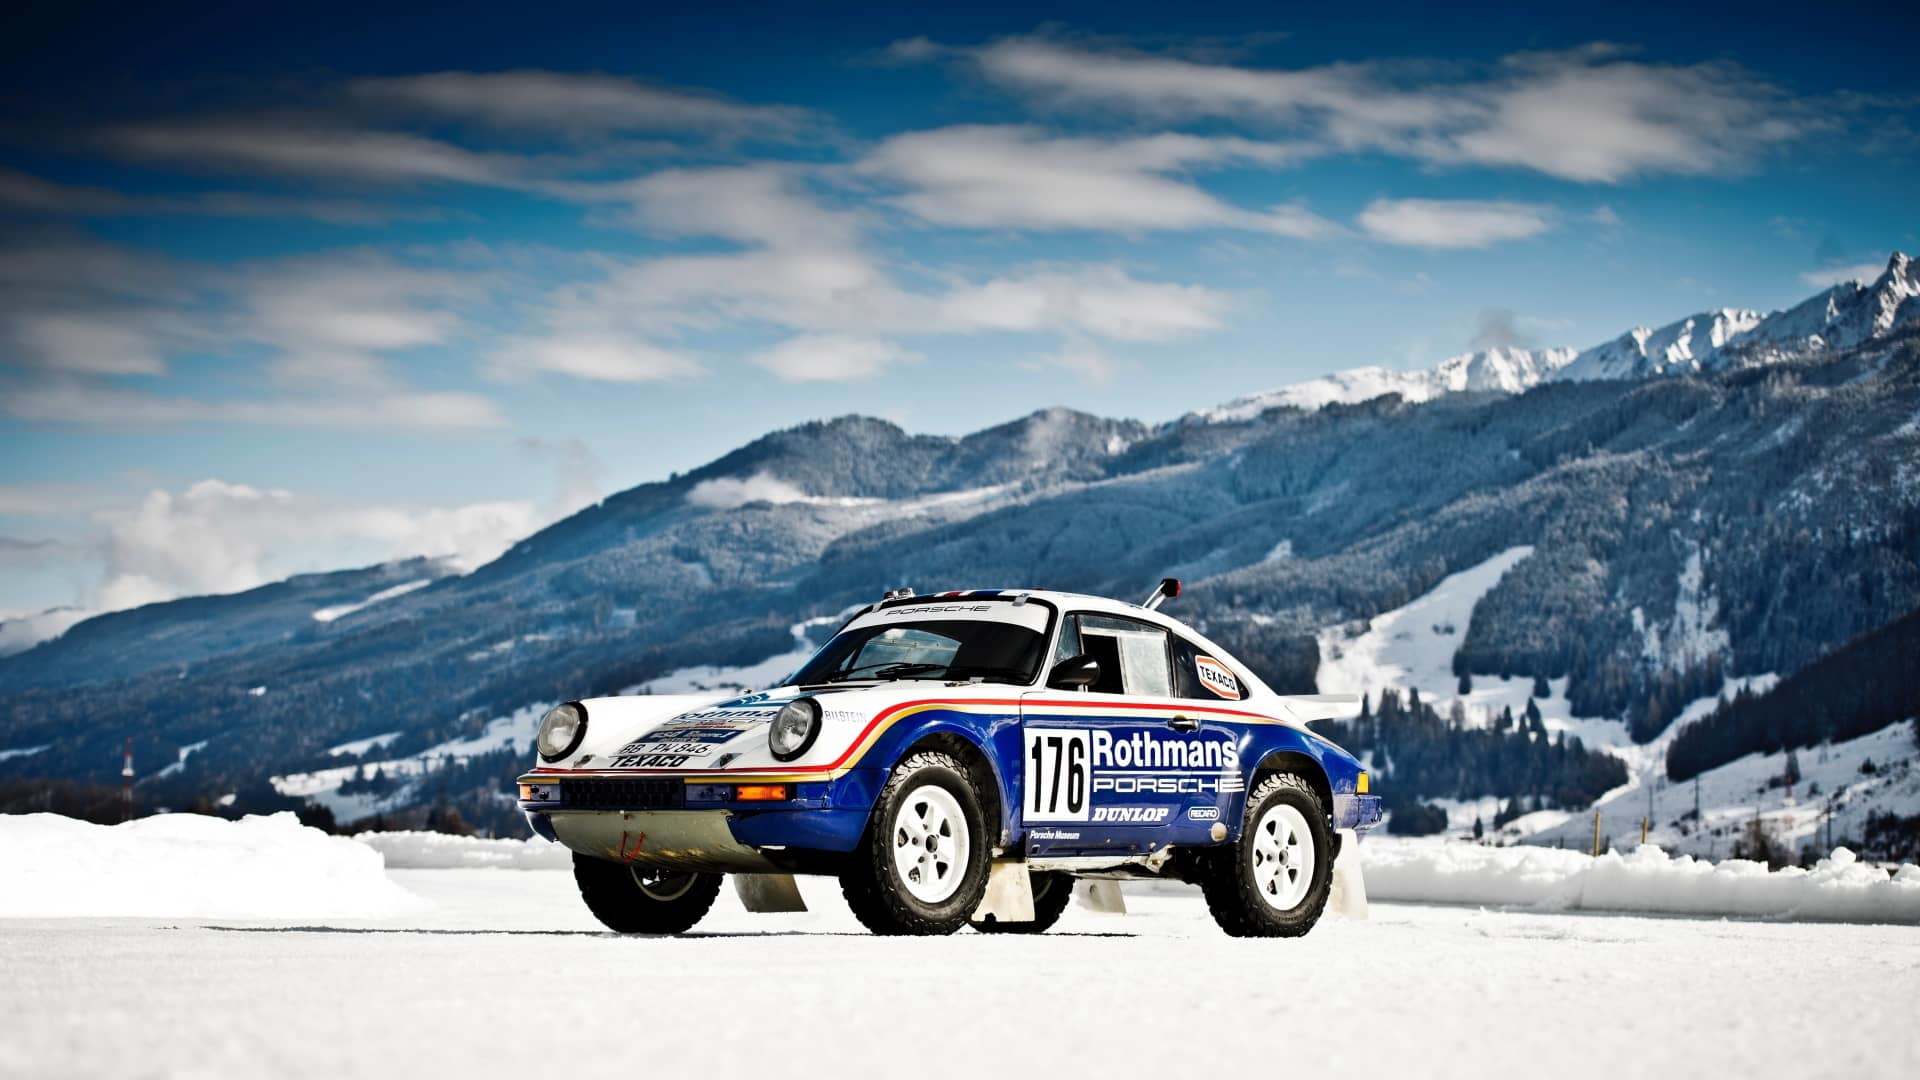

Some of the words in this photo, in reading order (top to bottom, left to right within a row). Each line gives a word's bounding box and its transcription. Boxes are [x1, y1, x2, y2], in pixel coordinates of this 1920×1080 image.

[885, 605, 991, 617] PORSCHE
[1199, 665, 1235, 690] TEXACO
[824, 710, 867, 723] BILSTEIN
[619, 744, 646, 754] BB
[674, 743, 711, 754] 846
[1092, 730, 1240, 768] Rothmans
[609, 755, 690, 768] TEXACO
[1031, 736, 1085, 814] 176
[1093, 778, 1246, 793] PORSCHE
[1092, 807, 1169, 822] DUNLOP
[1029, 830, 1055, 840] Porsche
[1055, 830, 1080, 840] Museum
